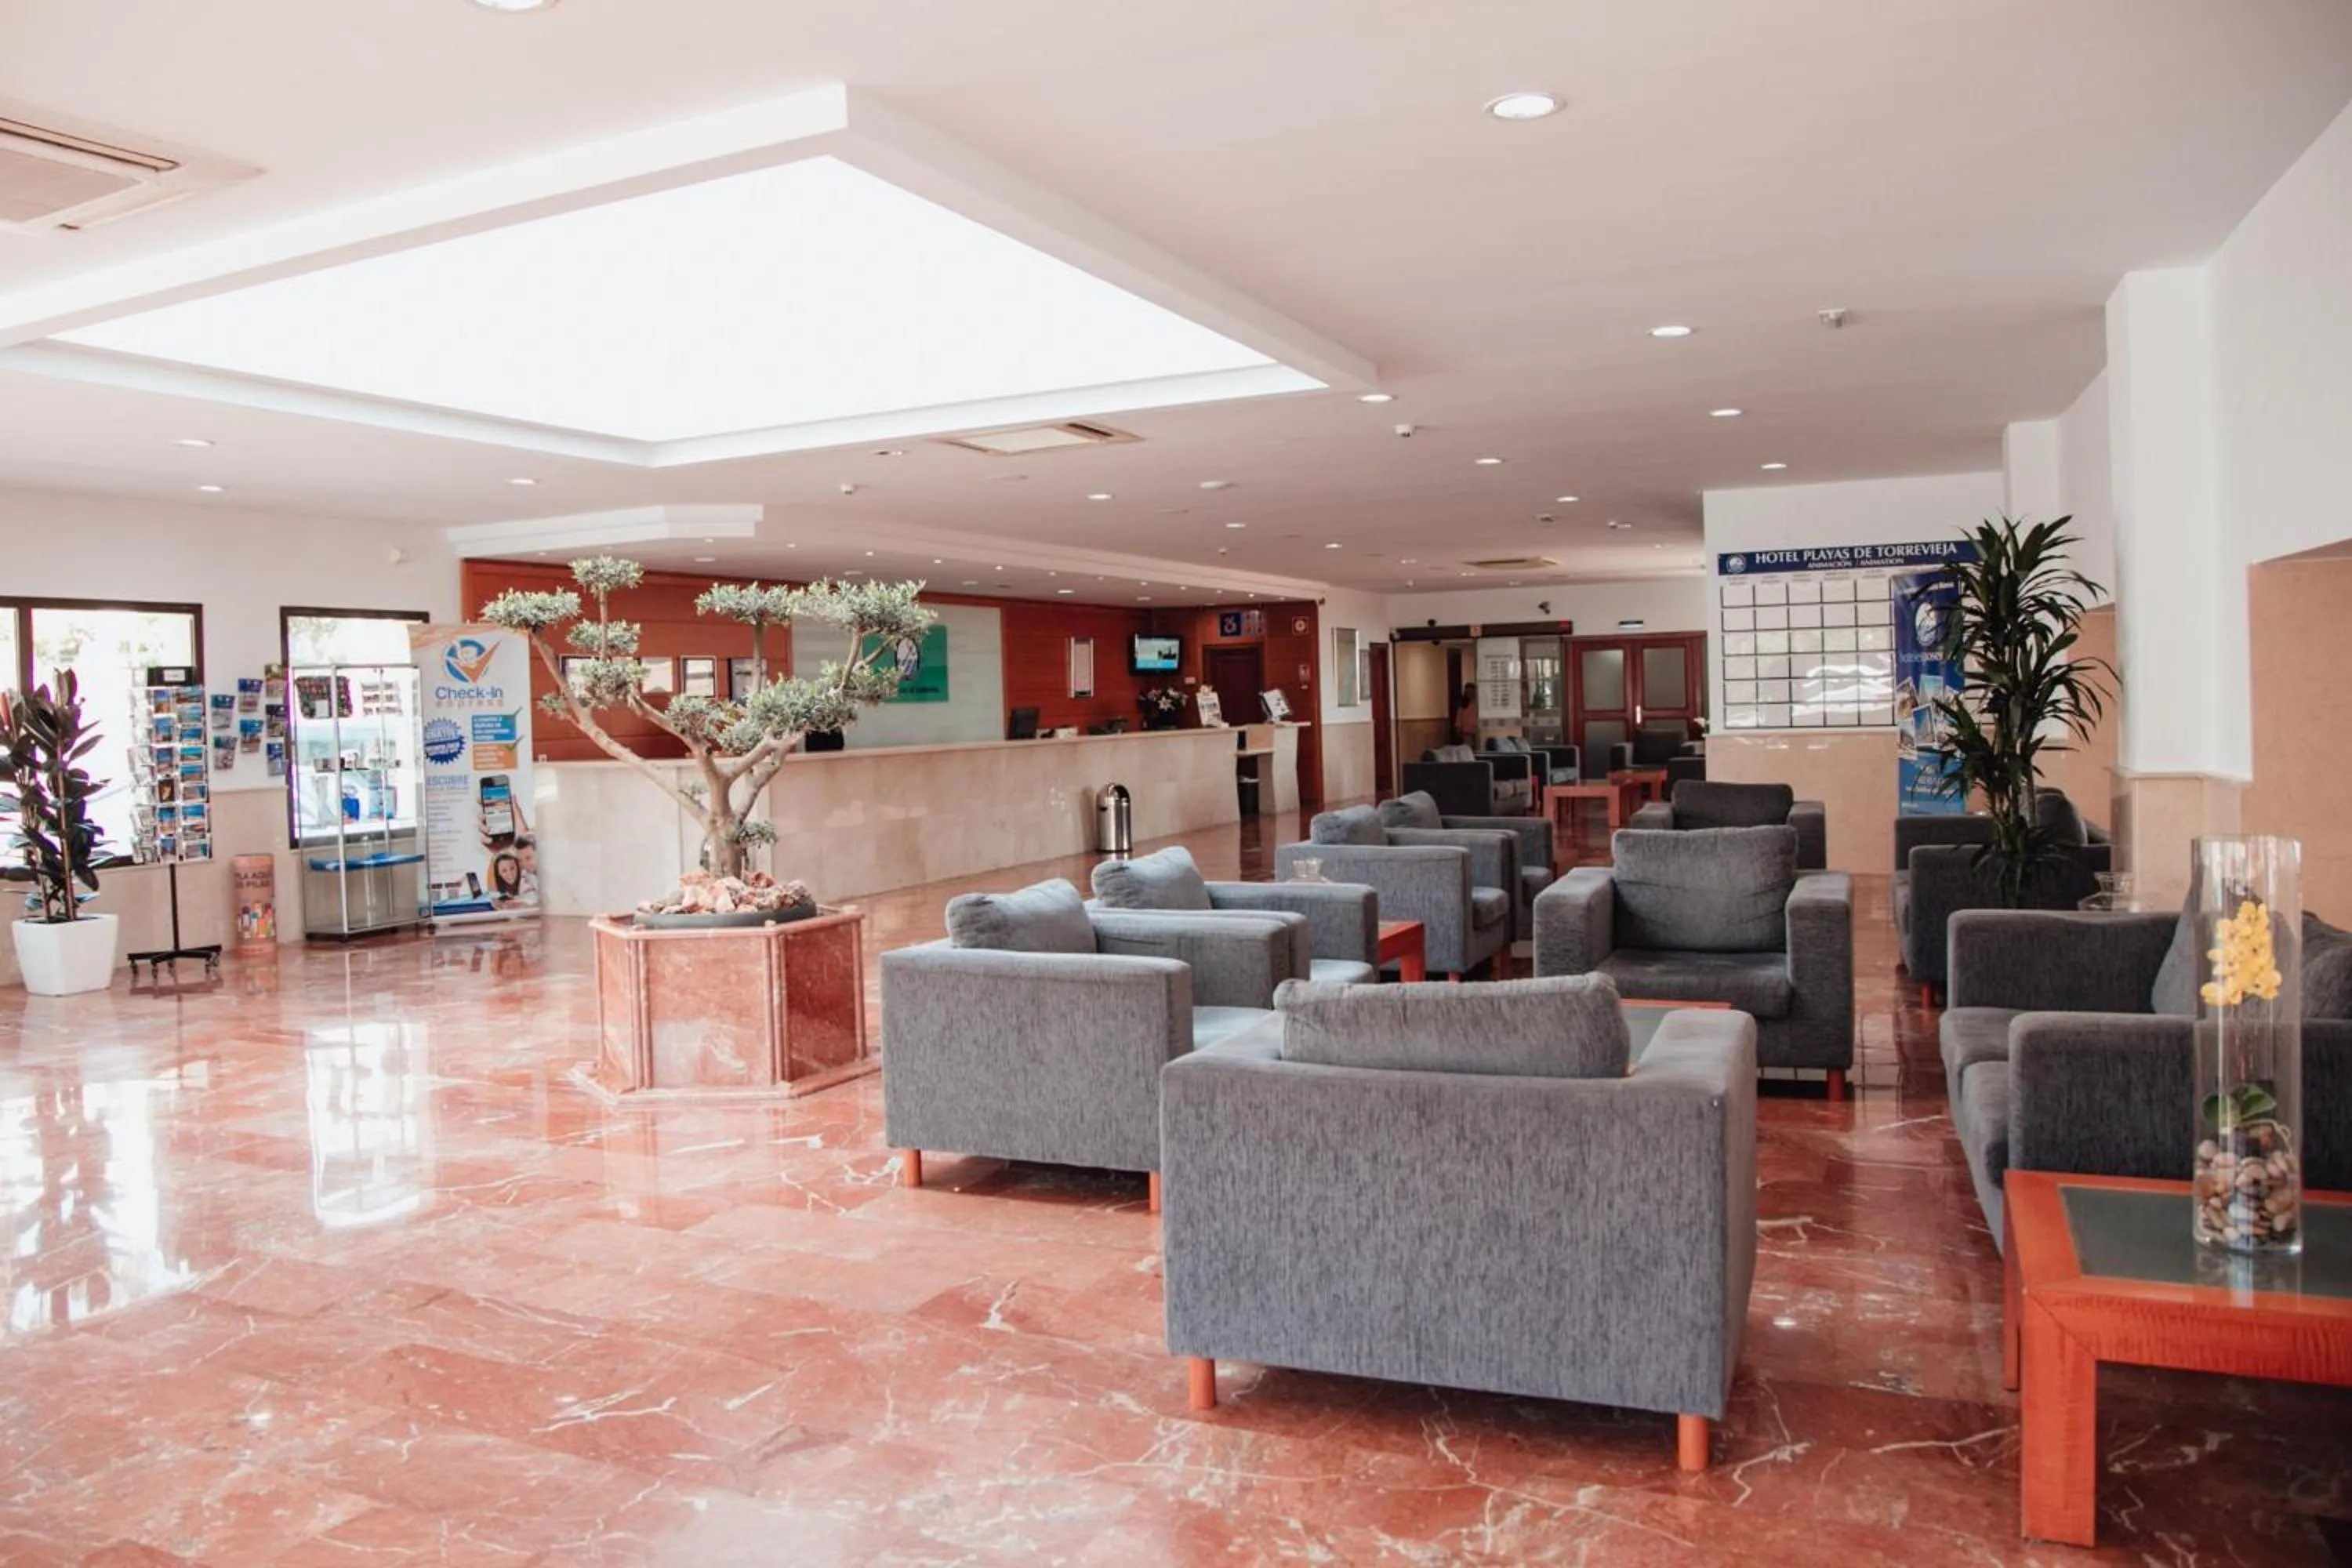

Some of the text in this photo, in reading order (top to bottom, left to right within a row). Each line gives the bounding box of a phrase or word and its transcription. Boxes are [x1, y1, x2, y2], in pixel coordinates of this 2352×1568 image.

[1755, 542, 1958, 564] HOTEL PLAYAS DE TORREVIEJA
